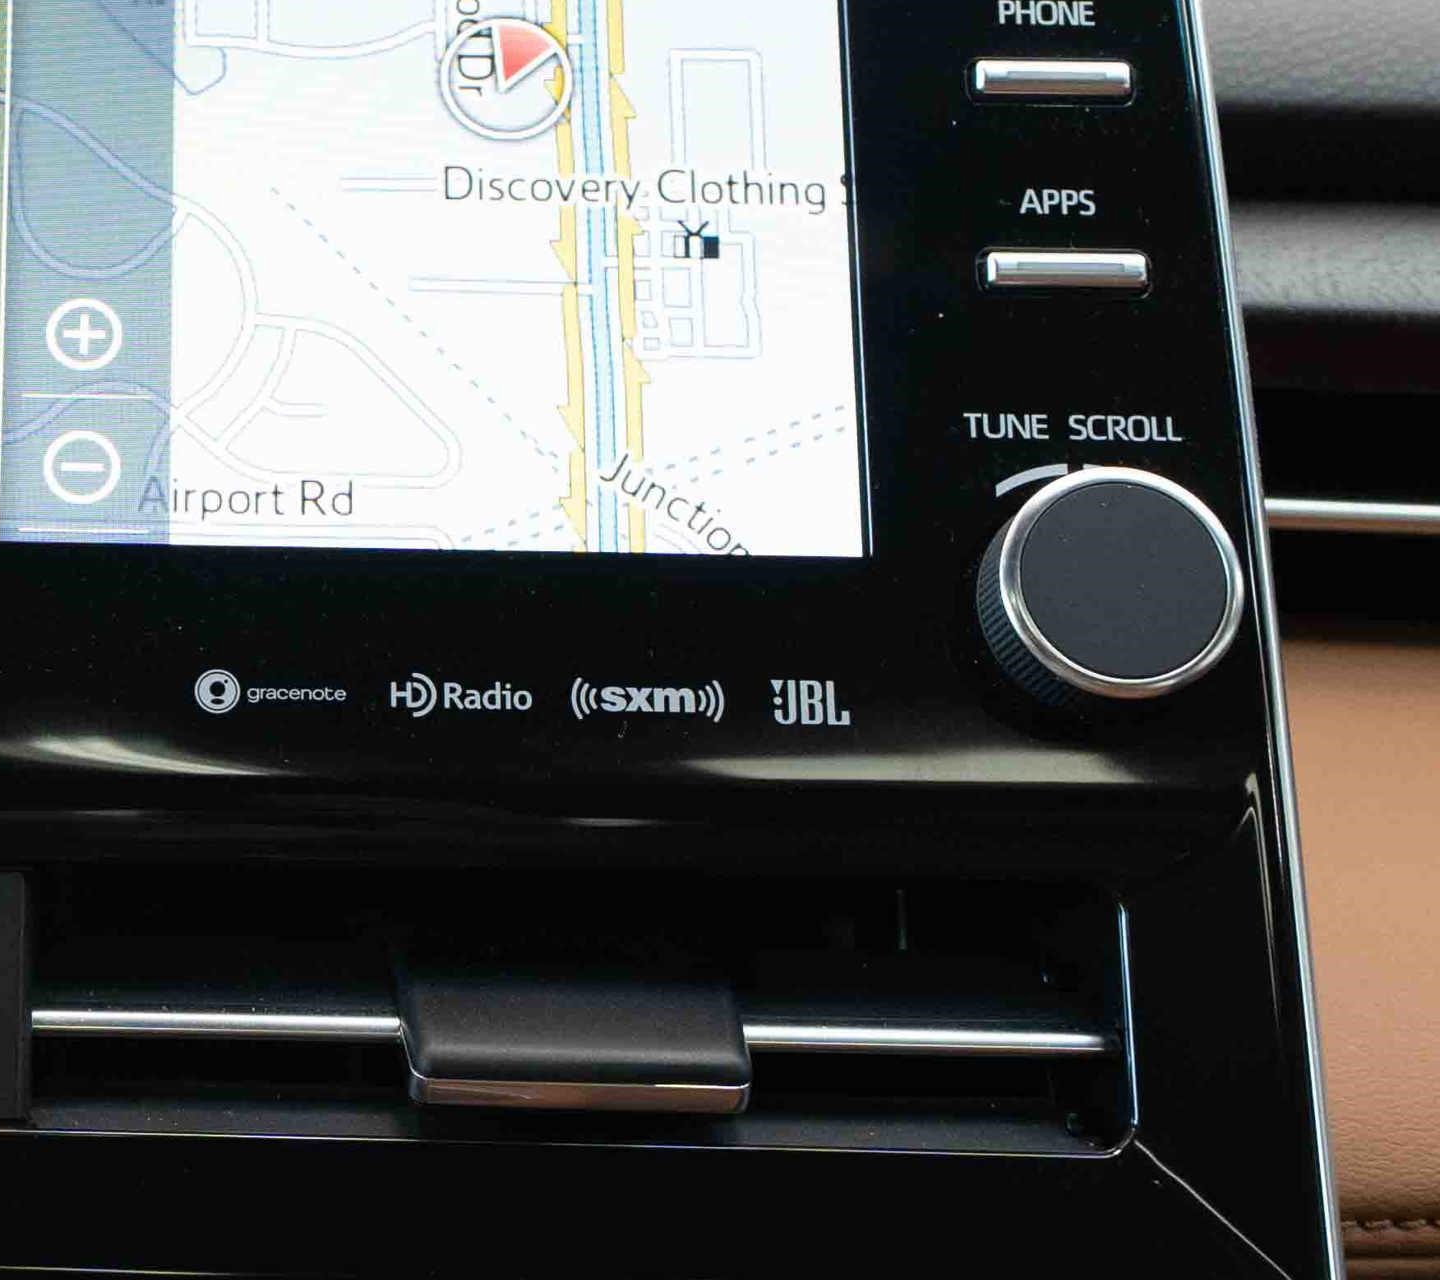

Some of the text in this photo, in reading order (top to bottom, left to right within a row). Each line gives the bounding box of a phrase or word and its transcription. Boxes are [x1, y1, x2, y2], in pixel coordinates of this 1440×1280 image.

[998, 0, 1096, 26] PHONE
[458, 53, 494, 97] Dr
[444, 166, 640, 209] Discovery
[657, 169, 826, 215] Clothing
[1020, 189, 1096, 216] APPS
[963, 413, 1182, 442] TUNE SCROLL
[138, 476, 353, 520] Airport Rd
[247, 687, 347, 703] gracenote
[390, 676, 533, 713] HD Radio
[772, 679, 850, 726] JBL
